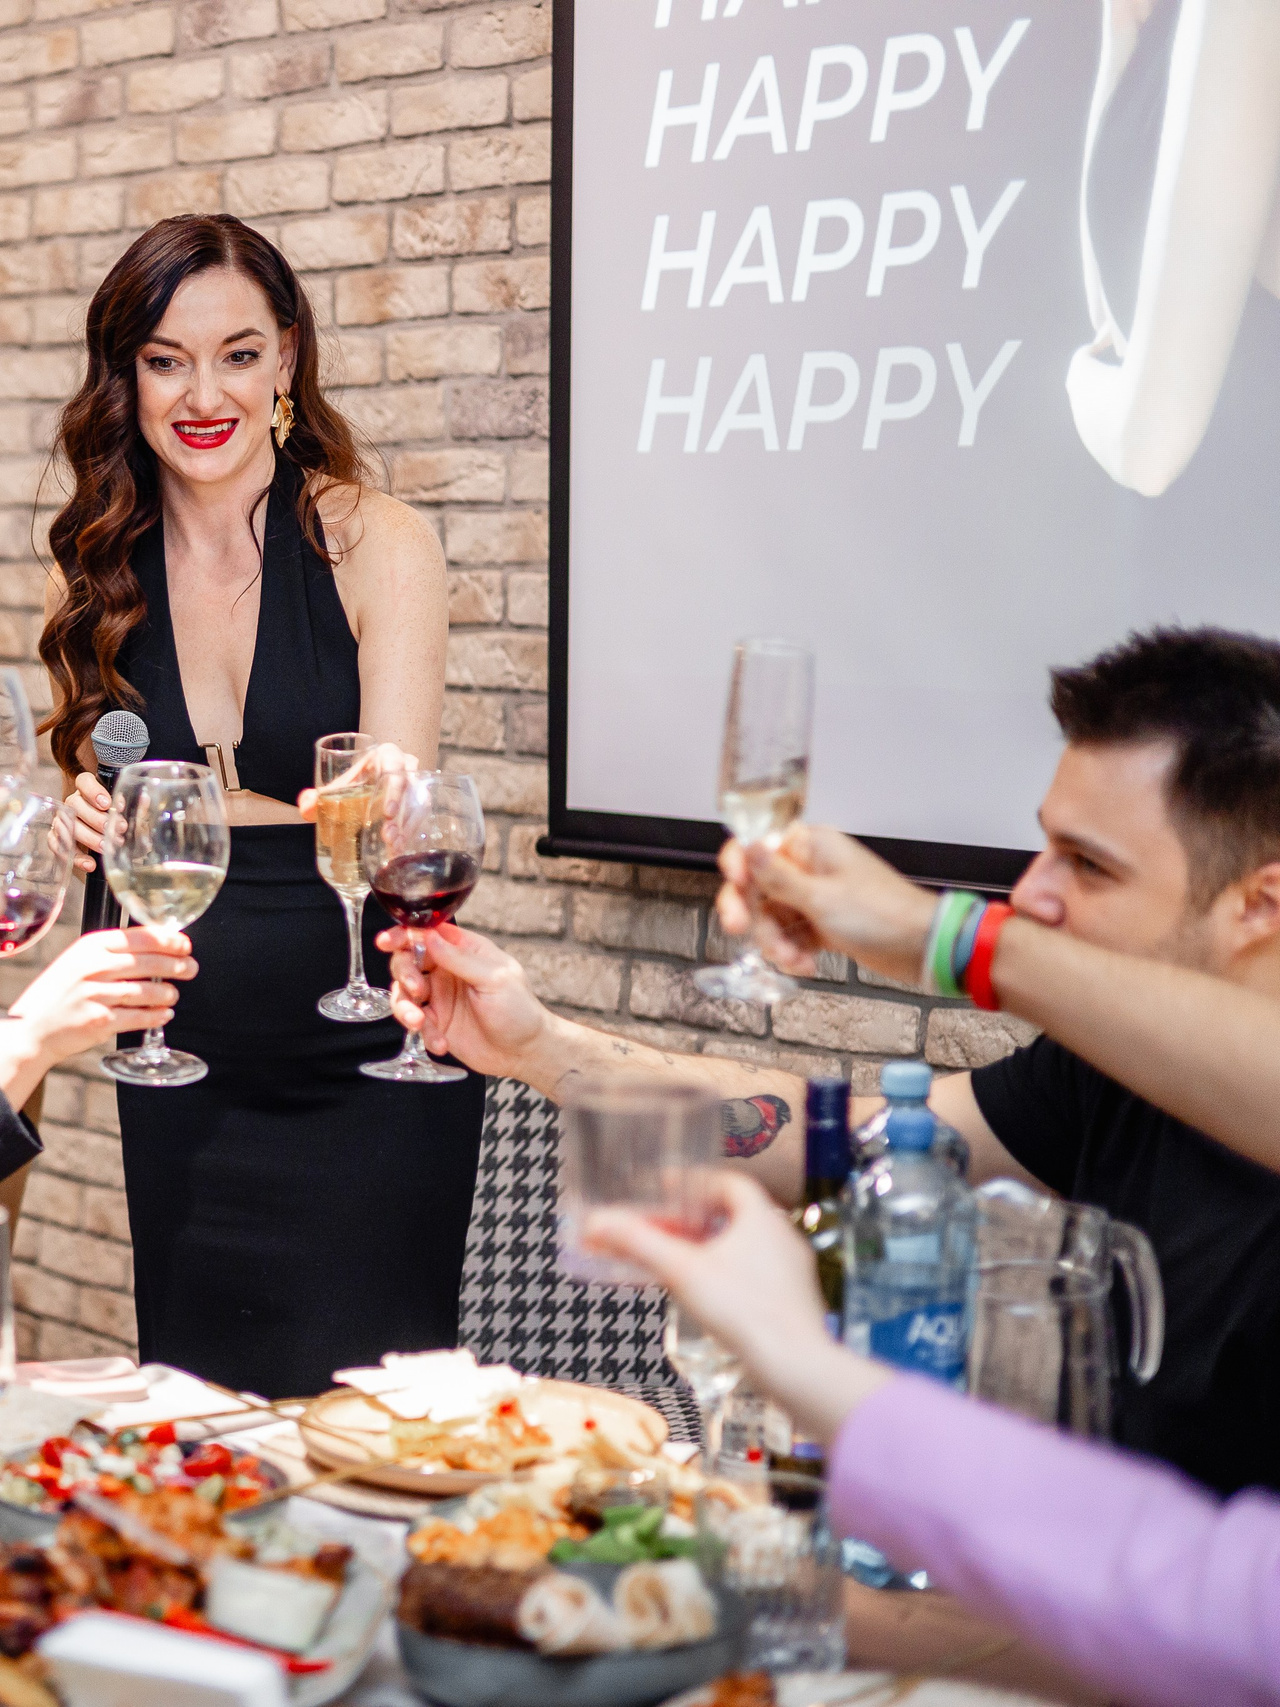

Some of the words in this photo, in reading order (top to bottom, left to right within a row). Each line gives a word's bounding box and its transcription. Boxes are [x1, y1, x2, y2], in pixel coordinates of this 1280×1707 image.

[644, 17, 1032, 169] HAPPY
[640, 179, 1027, 311] HAPPY
[636, 339, 1023, 453] HAPPY
